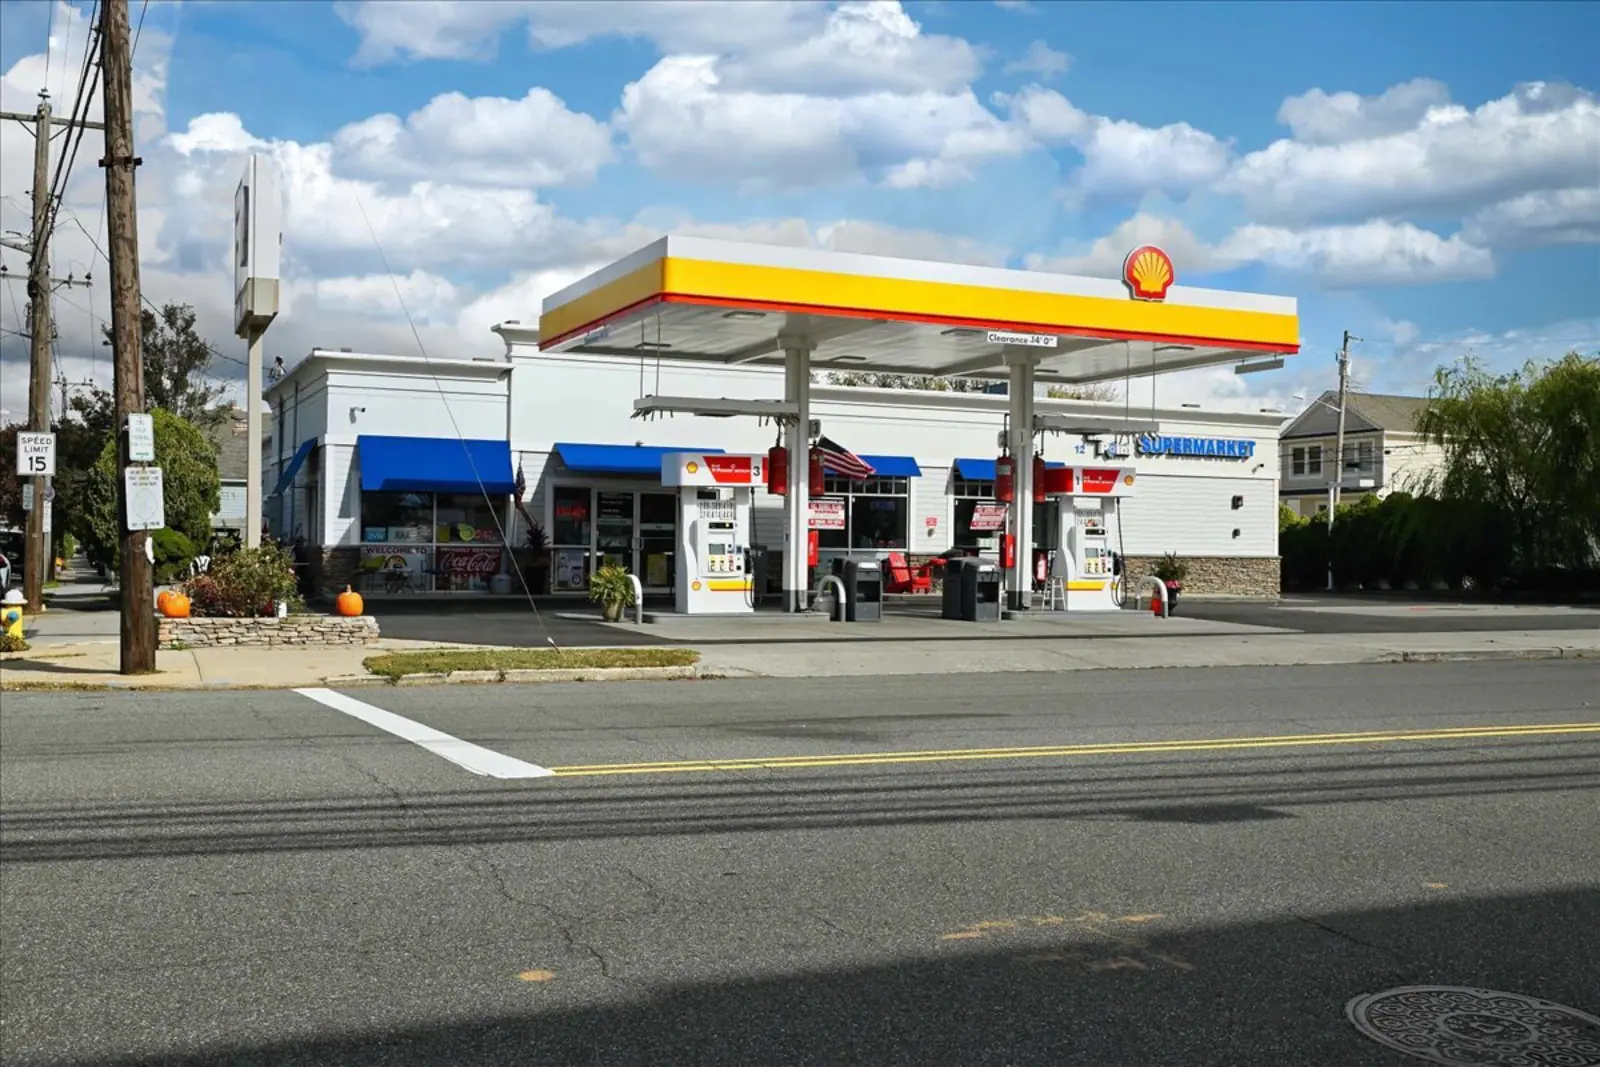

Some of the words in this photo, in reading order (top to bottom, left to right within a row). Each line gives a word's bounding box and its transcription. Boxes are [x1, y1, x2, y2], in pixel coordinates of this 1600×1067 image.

[988, 333, 1028, 344] Clearance
[21, 436, 53, 445] SPEED
[1140, 434, 1256, 458] SUPERMARKET
[28, 456, 46, 472] 15
[753, 466, 761, 477] 3
[1075, 475, 1080, 486] 1
